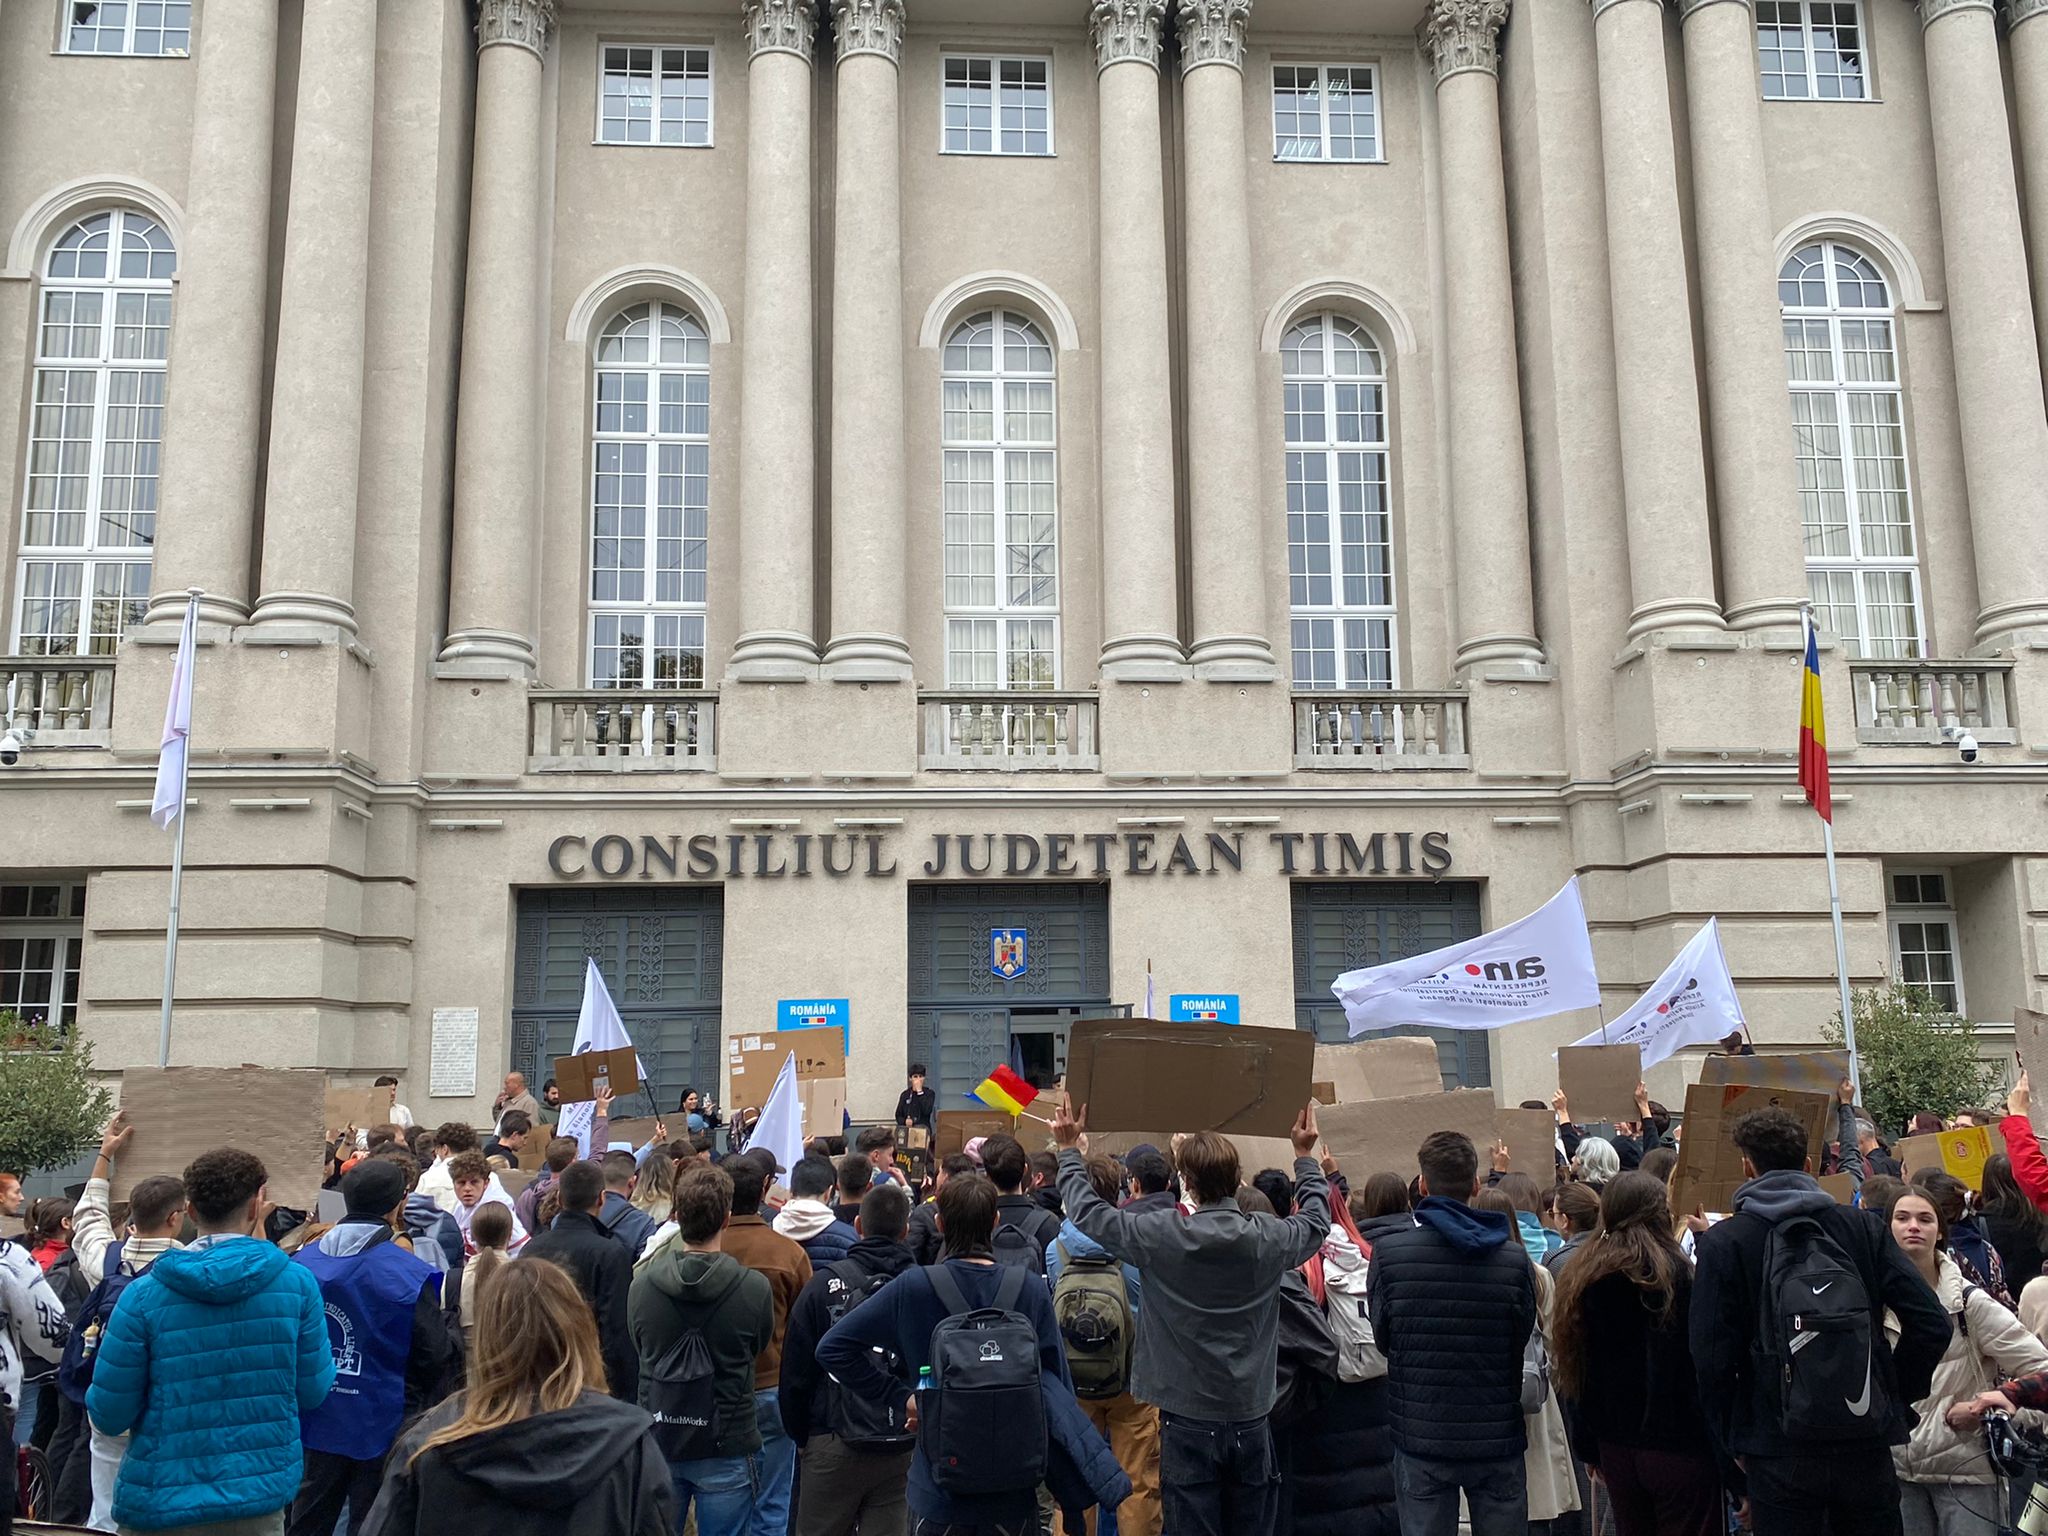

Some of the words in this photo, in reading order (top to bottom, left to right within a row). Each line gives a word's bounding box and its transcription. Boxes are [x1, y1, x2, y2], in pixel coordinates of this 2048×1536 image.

[547, 834, 898, 879] CONSILIUL
[325, 1302, 353, 1332] INDICATUL
[663, 1415, 708, 1426] MathWorks
